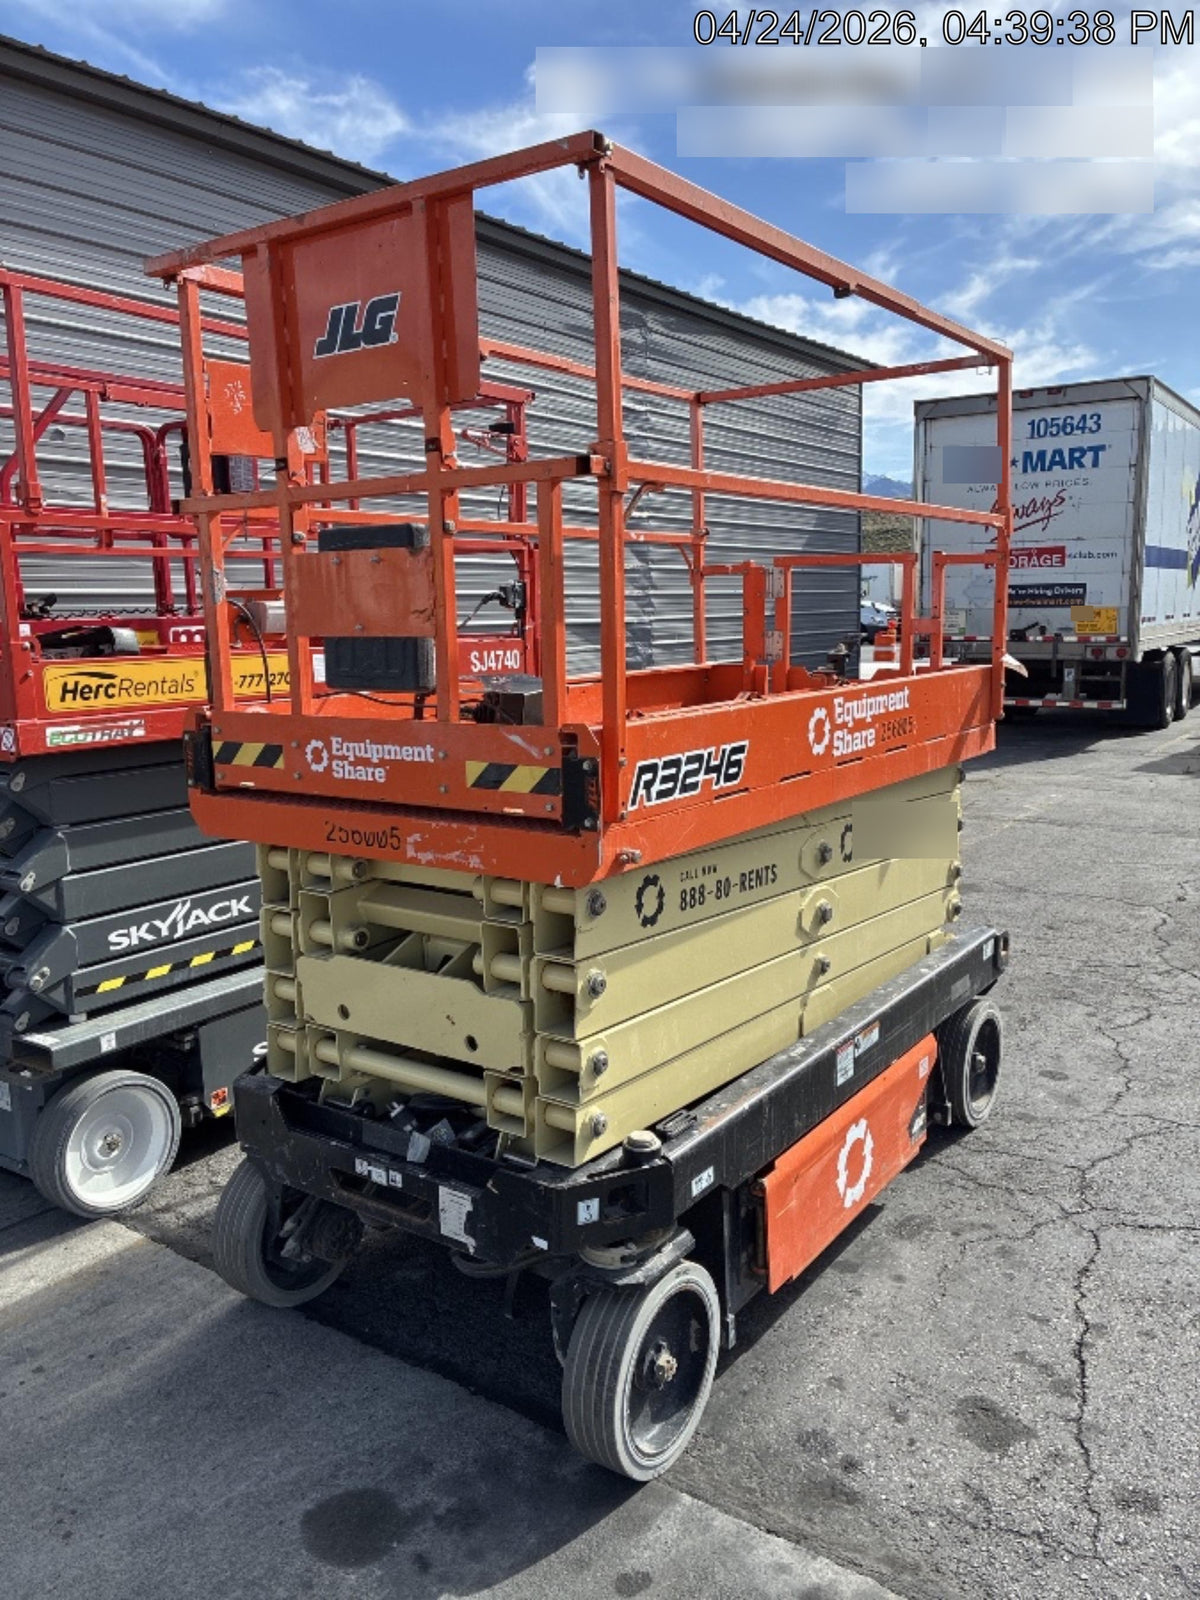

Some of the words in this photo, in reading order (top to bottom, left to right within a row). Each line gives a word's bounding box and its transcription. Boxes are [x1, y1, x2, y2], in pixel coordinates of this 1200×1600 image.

[313, 292, 400, 359] JLG
[1027, 413, 1102, 439] 105643
[1021, 444, 1107, 473] MART
[966, 484, 998, 494] ALWA
[1014, 481, 1039, 490] LOW
[1008, 553, 1063, 569] ORAGE
[470, 649, 520, 673] SJ4740
[833, 686, 910, 728] Equipment
[331, 736, 434, 764] Equipment
[832, 729, 876, 757] Share
[331, 760, 387, 783] Share
[627, 740, 750, 811] R3246
[680, 868, 698, 882] CALL
[680, 863, 778, 911] 888-80-RENTS
[107, 895, 254, 951] SKYJACK
